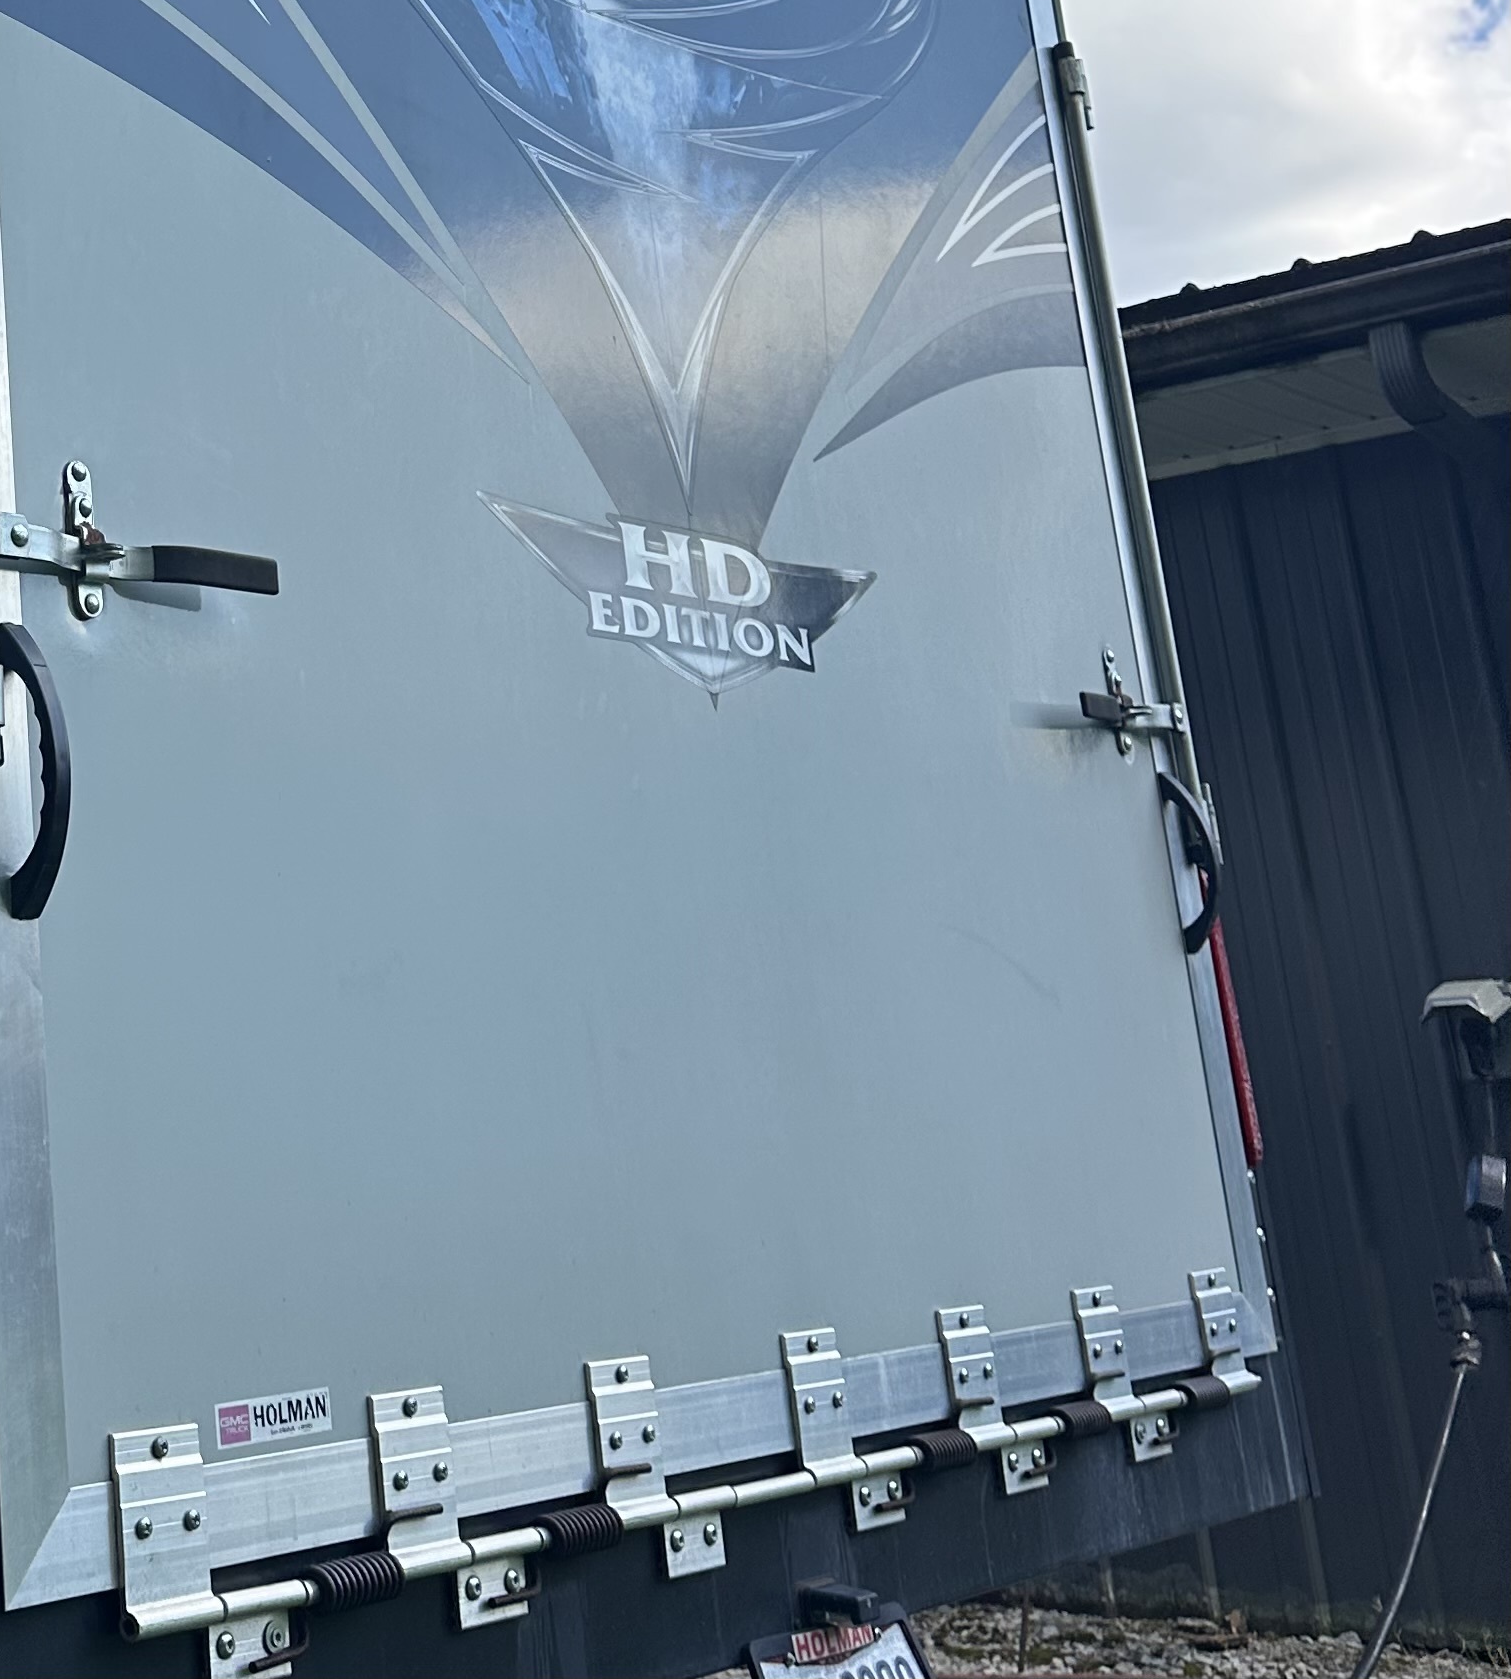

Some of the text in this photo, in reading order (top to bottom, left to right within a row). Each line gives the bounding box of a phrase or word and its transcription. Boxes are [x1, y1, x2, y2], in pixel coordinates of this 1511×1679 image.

[618, 521, 771, 608] HD
[588, 590, 812, 666] EDITION
[220, 1413, 249, 1428] GMC
[253, 1394, 327, 1428] HOLMAN
[795, 1624, 872, 1662] HOLMAN
